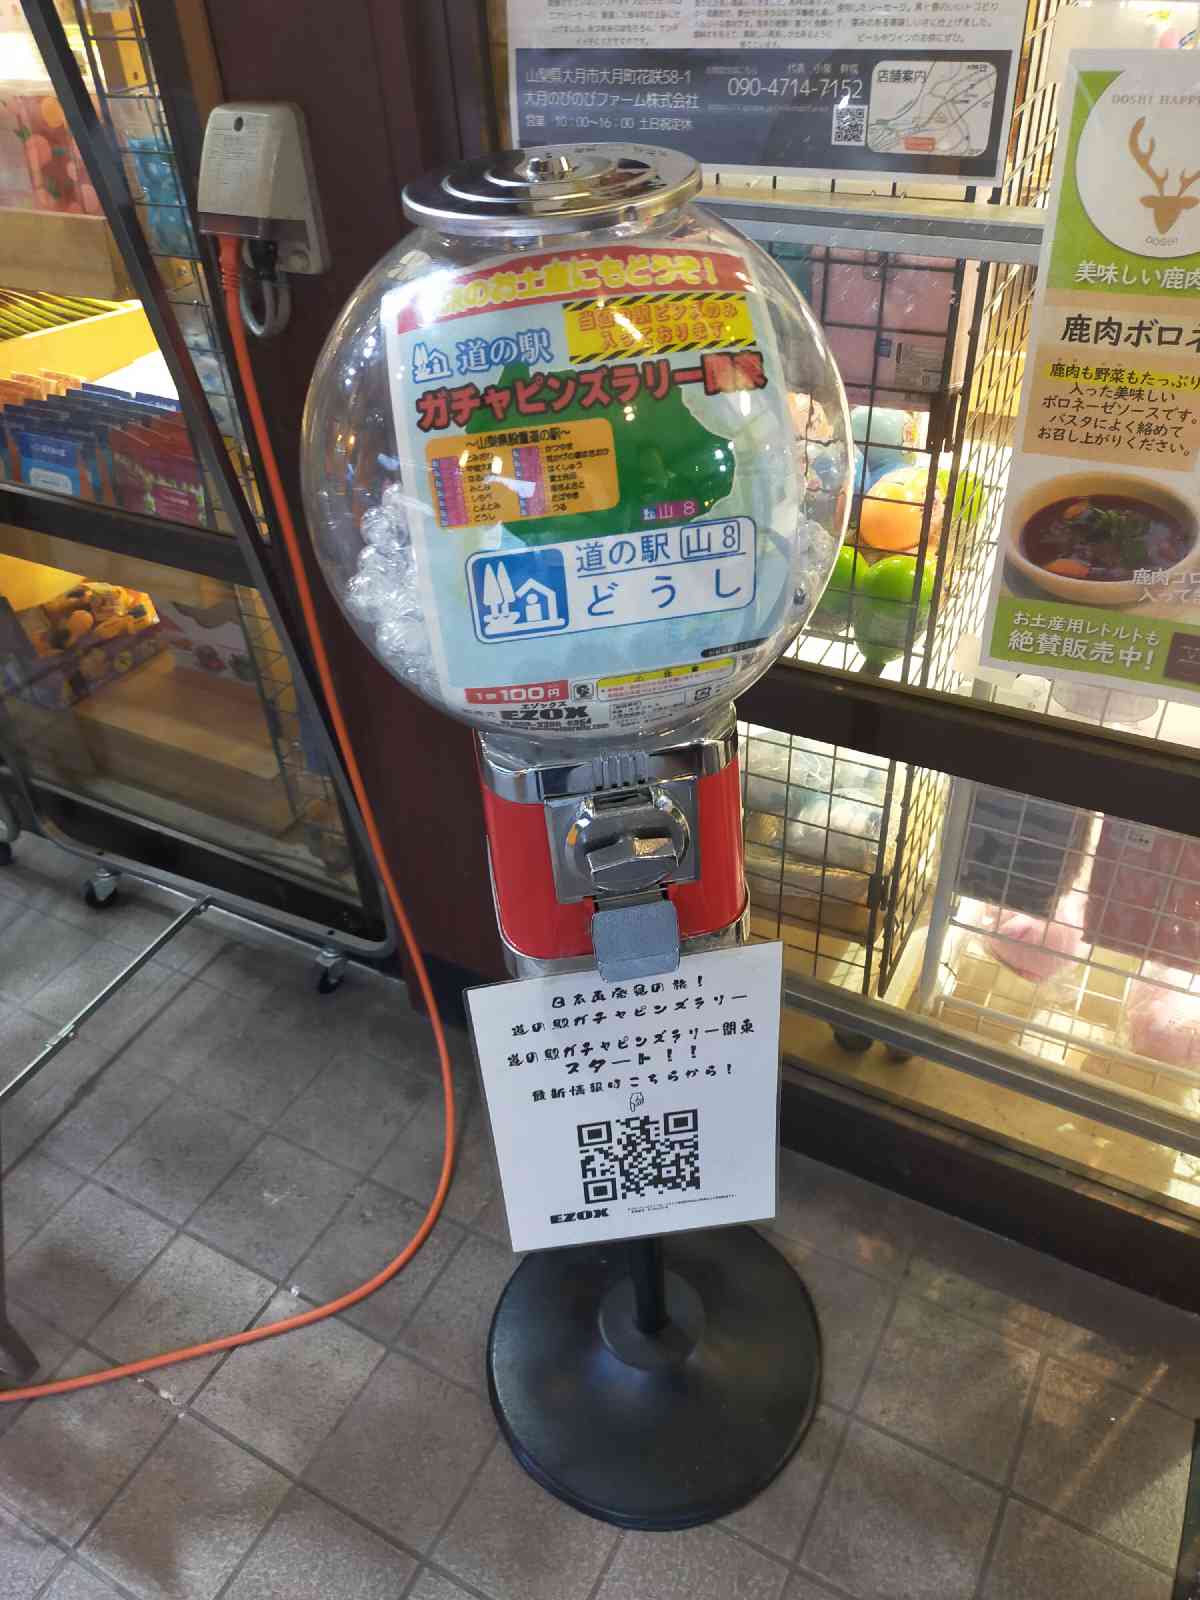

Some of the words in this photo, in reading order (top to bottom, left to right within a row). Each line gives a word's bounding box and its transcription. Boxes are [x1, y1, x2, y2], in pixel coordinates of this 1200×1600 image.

[727, 77, 863, 99] 090-4714-7152
[878, 69, 927, 84] 店舗案内
[523, 90, 700, 109] 大月のびのびファーム株式会社
[1160, 96, 1200, 105] HAPP
[446, 255, 717, 310] のお土産にもどうぞ!
[1075, 260, 1200, 289] 美味しい鹿肉
[456, 328, 556, 376] 道の駅
[1050, 363, 1200, 389] 鹿肉も野菜もたっぷり
[1070, 382, 1175, 403] 入った美味しい
[1041, 395, 1197, 424] ボロネーゼソースです。
[1050, 415, 1184, 438] パスタによく絡めて
[1038, 427, 1190, 456] お召し上がりください。
[576, 534, 670, 573] 道の駅
[588, 568, 742, 617] どうし
[1013, 611, 1160, 646] お土産用レトルトも
[1008, 629, 1154, 670] 絶賛販売中!
[501, 706, 589, 721] EZOX
[512, 994, 748, 1036] 道の駅ガチャピンズラリー
[507, 1018, 755, 1067] 道の駅ガチャピンズラリー関東
[532, 1063, 732, 1102] 最新情報はこちらから!
[550, 1207, 610, 1224] EZOX
